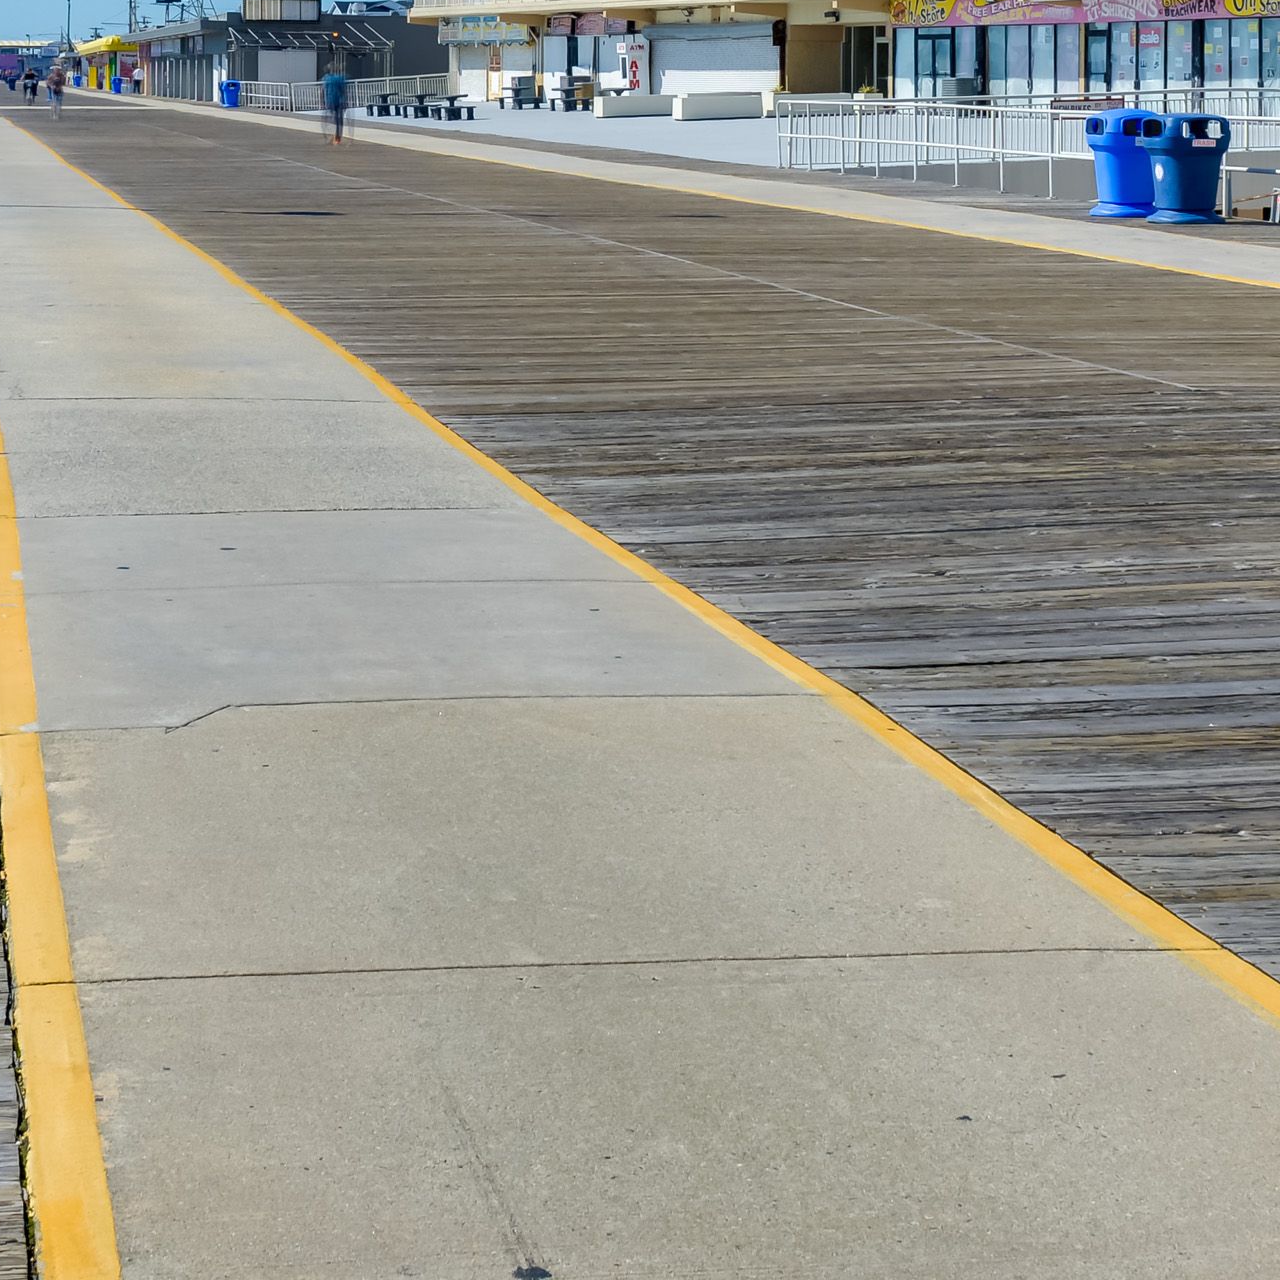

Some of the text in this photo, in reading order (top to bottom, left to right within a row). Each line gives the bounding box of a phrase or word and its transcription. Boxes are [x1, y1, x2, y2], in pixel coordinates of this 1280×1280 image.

[967, 1, 987, 17] FREE
[991, 0, 1011, 14] EAR
[1140, 30, 1160, 43] sale
[629, 59, 640, 89] ATM
